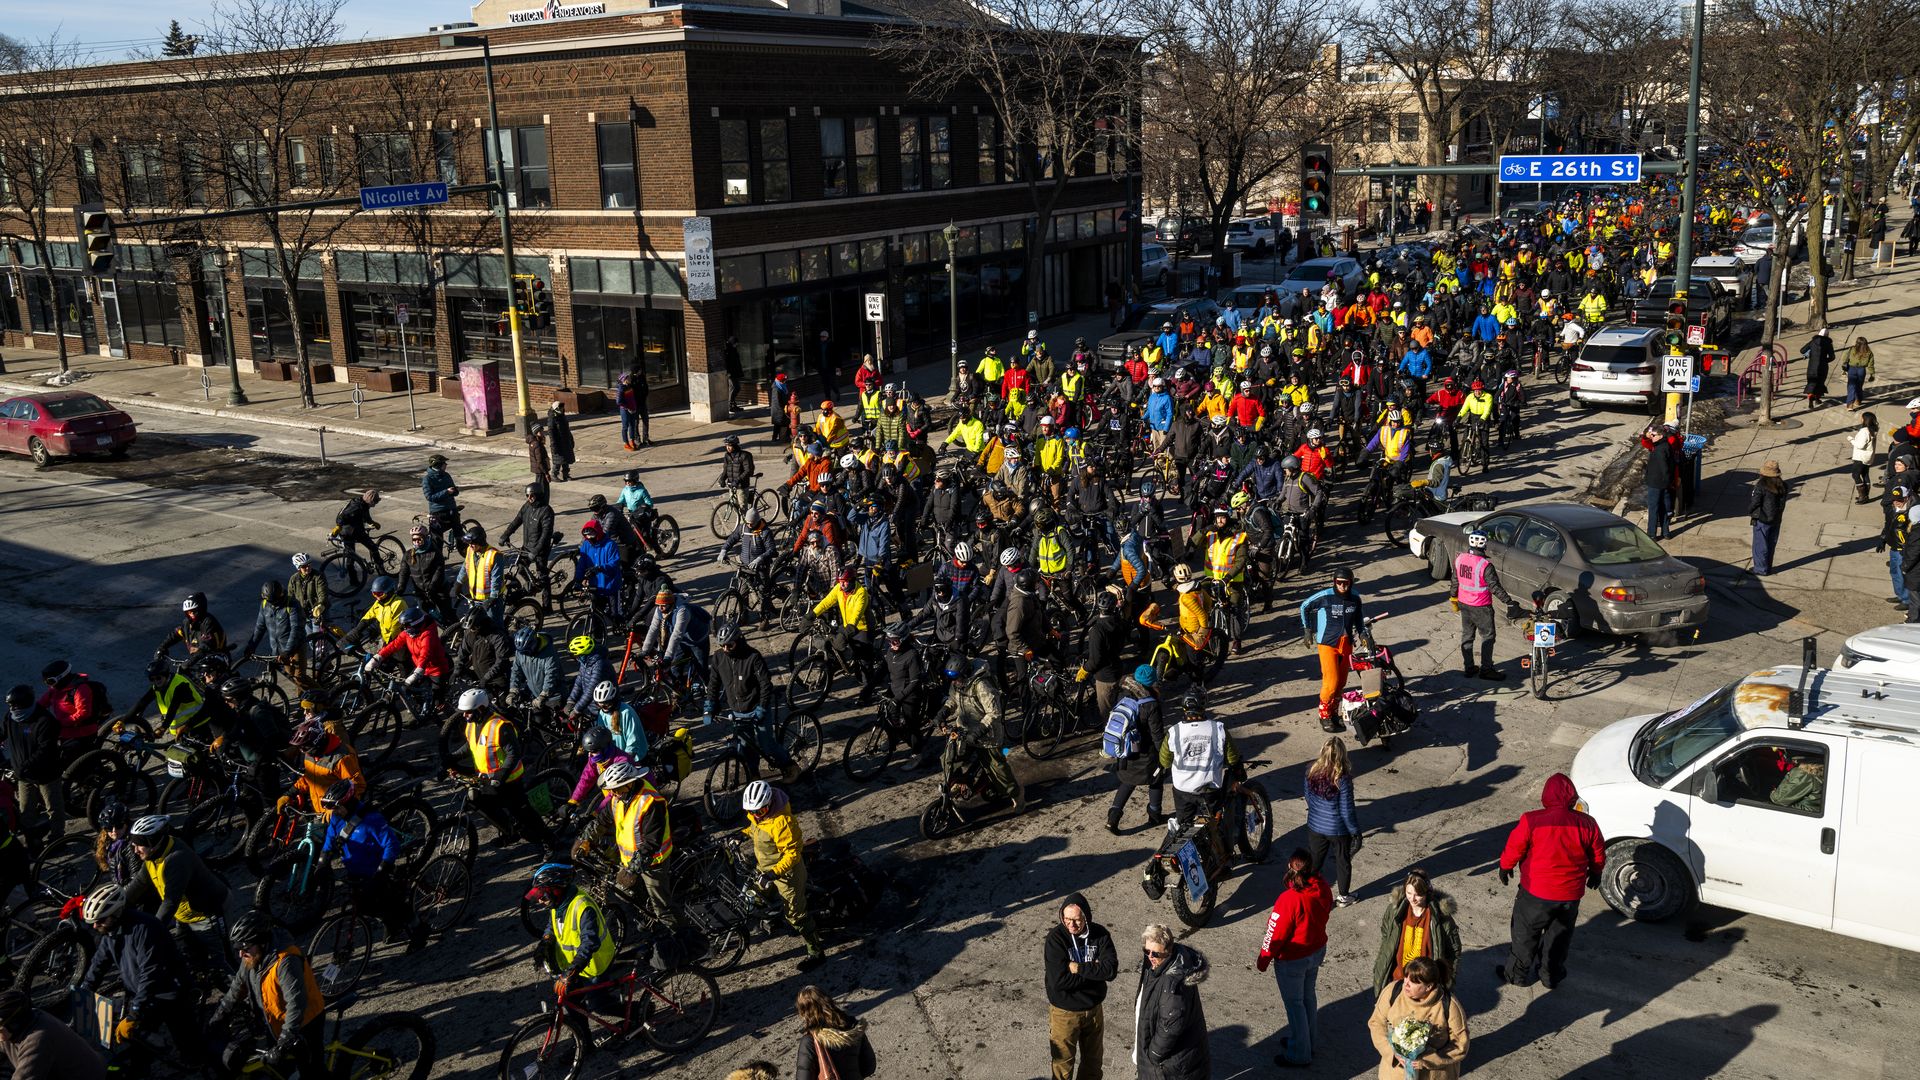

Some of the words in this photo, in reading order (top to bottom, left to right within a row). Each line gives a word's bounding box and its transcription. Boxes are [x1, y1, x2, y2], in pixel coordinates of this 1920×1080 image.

[509, 11, 544, 23] VERTICAL
[554, 4, 603, 18] ENDEAVORS
[1530, 161, 1542, 177] E
[1551, 161, 1601, 177] 26th
[1611, 160, 1635, 177] St
[365, 189, 420, 205] Nicollet
[426, 187, 443, 200] Av
[1668, 358, 1688, 368] ONE
[1667, 368, 1688, 377] WAY
